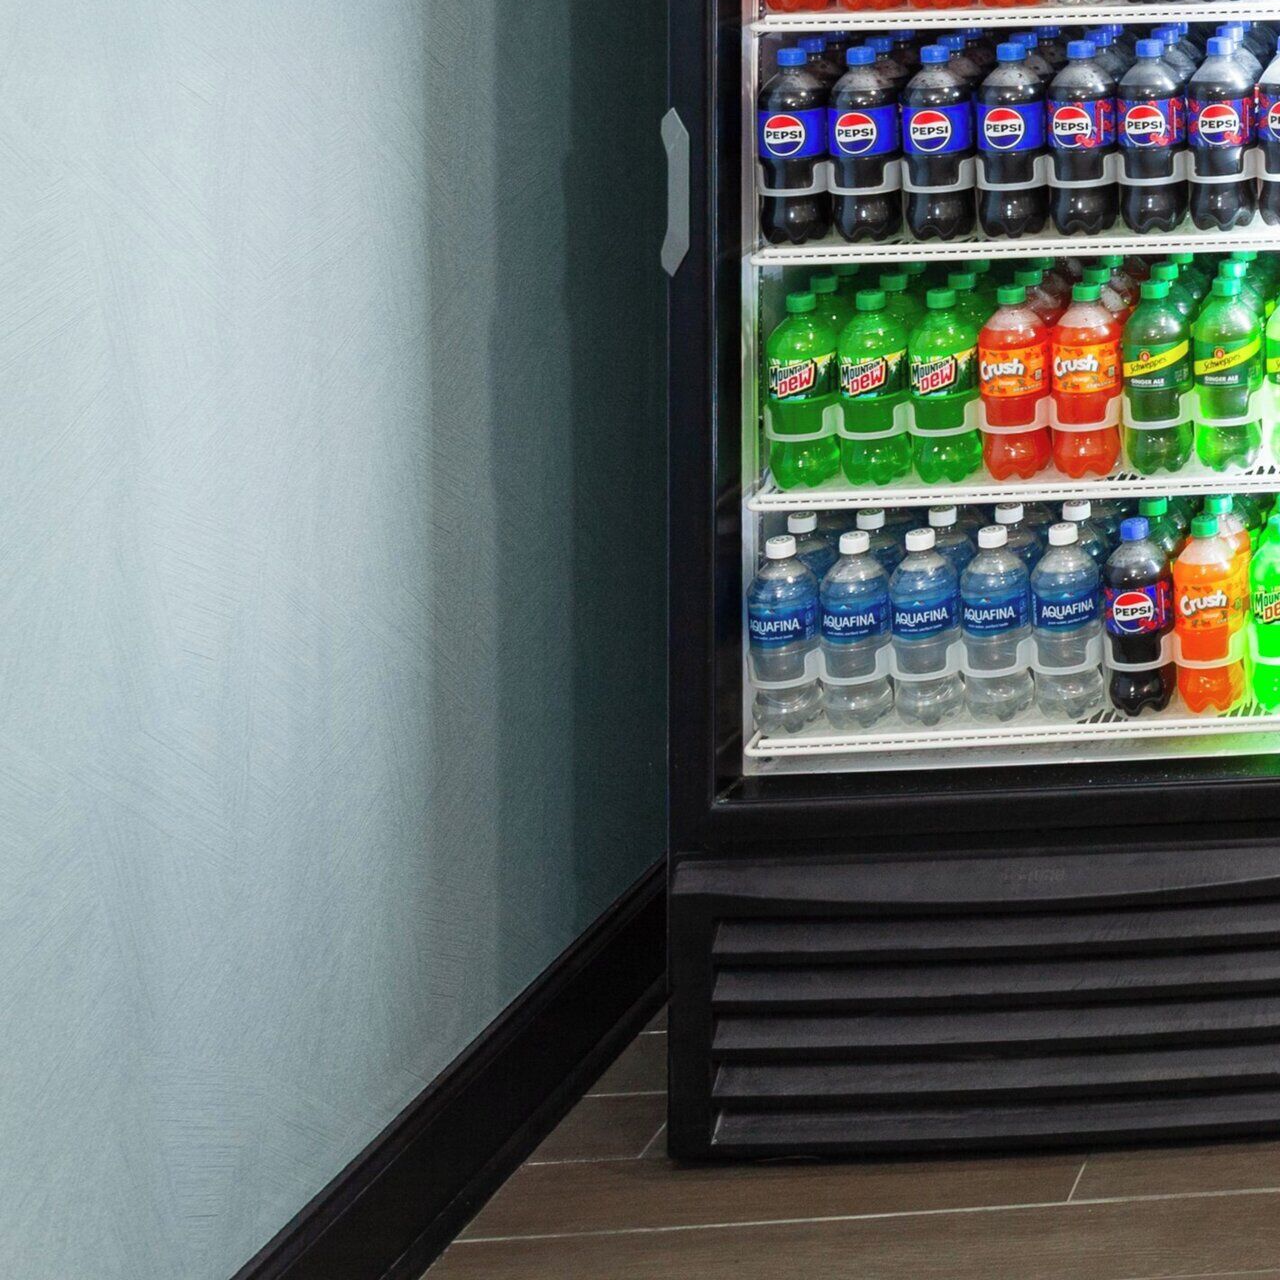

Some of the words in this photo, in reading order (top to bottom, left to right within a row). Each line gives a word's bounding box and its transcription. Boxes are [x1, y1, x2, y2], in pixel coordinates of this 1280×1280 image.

[912, 126, 948, 135] PEPSI
[986, 124, 1022, 133] PEPSI
[1054, 122, 1089, 131] PEPSI
[1127, 120, 1163, 129] PEPSI
[1200, 119, 1237, 128] PEPSI
[766, 131, 802, 140] PEPSI
[837, 128, 874, 137] PEPSI
[981, 358, 1025, 381] Crush
[1054, 356, 1098, 377] Crush
[1042, 599, 1093, 619] AQUAFINA
[1116, 603, 1151, 616] PEPSI
[1180, 590, 1227, 615] Crush
[823, 613, 875, 630] AQUAFINA
[895, 607, 948, 624] AQUAFINA
[964, 606, 1014, 623] AQUAFINA
[750, 618, 800, 634] AQUAFINA
